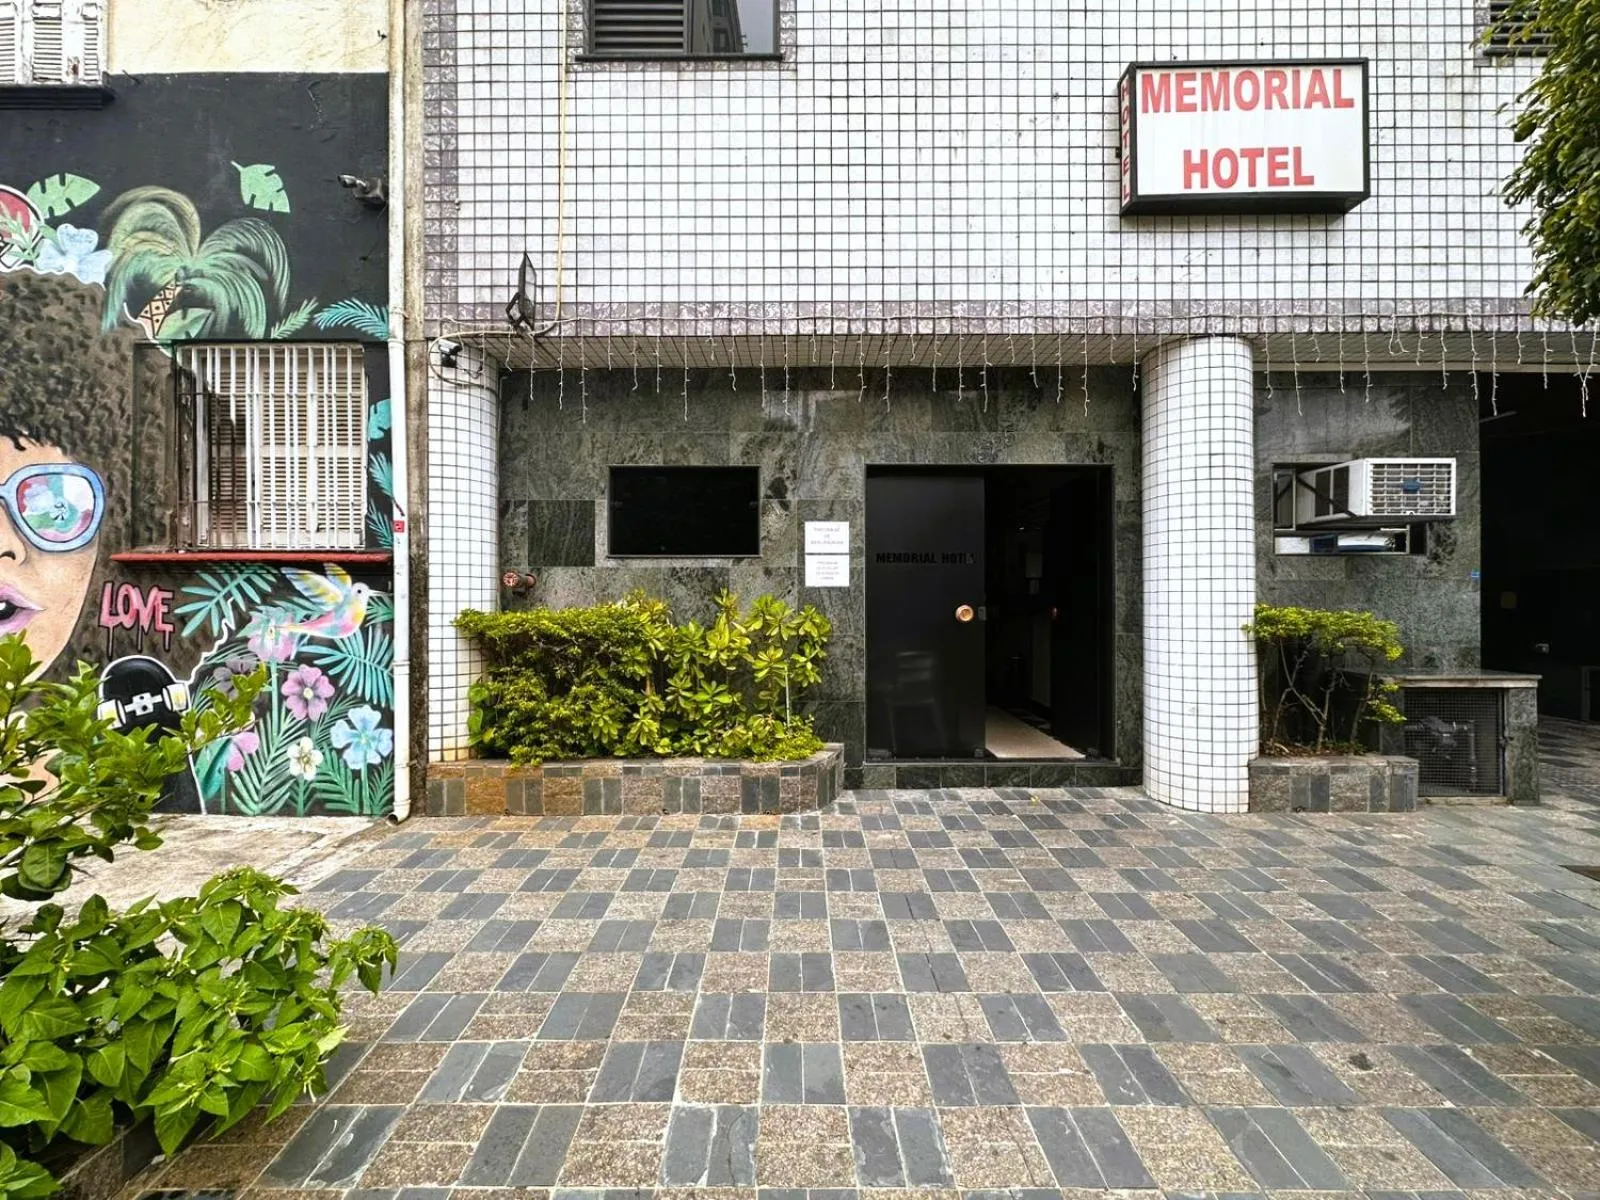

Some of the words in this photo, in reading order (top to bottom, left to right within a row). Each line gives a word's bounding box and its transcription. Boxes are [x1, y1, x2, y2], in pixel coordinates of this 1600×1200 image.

[1141, 69, 1355, 113] MEMORIAL
[1121, 83, 1131, 200] HOTEL
[1183, 146, 1315, 189] HOTEL
[876, 552, 938, 564] MEMORIAL
[98, 581, 175, 640] LOVE
